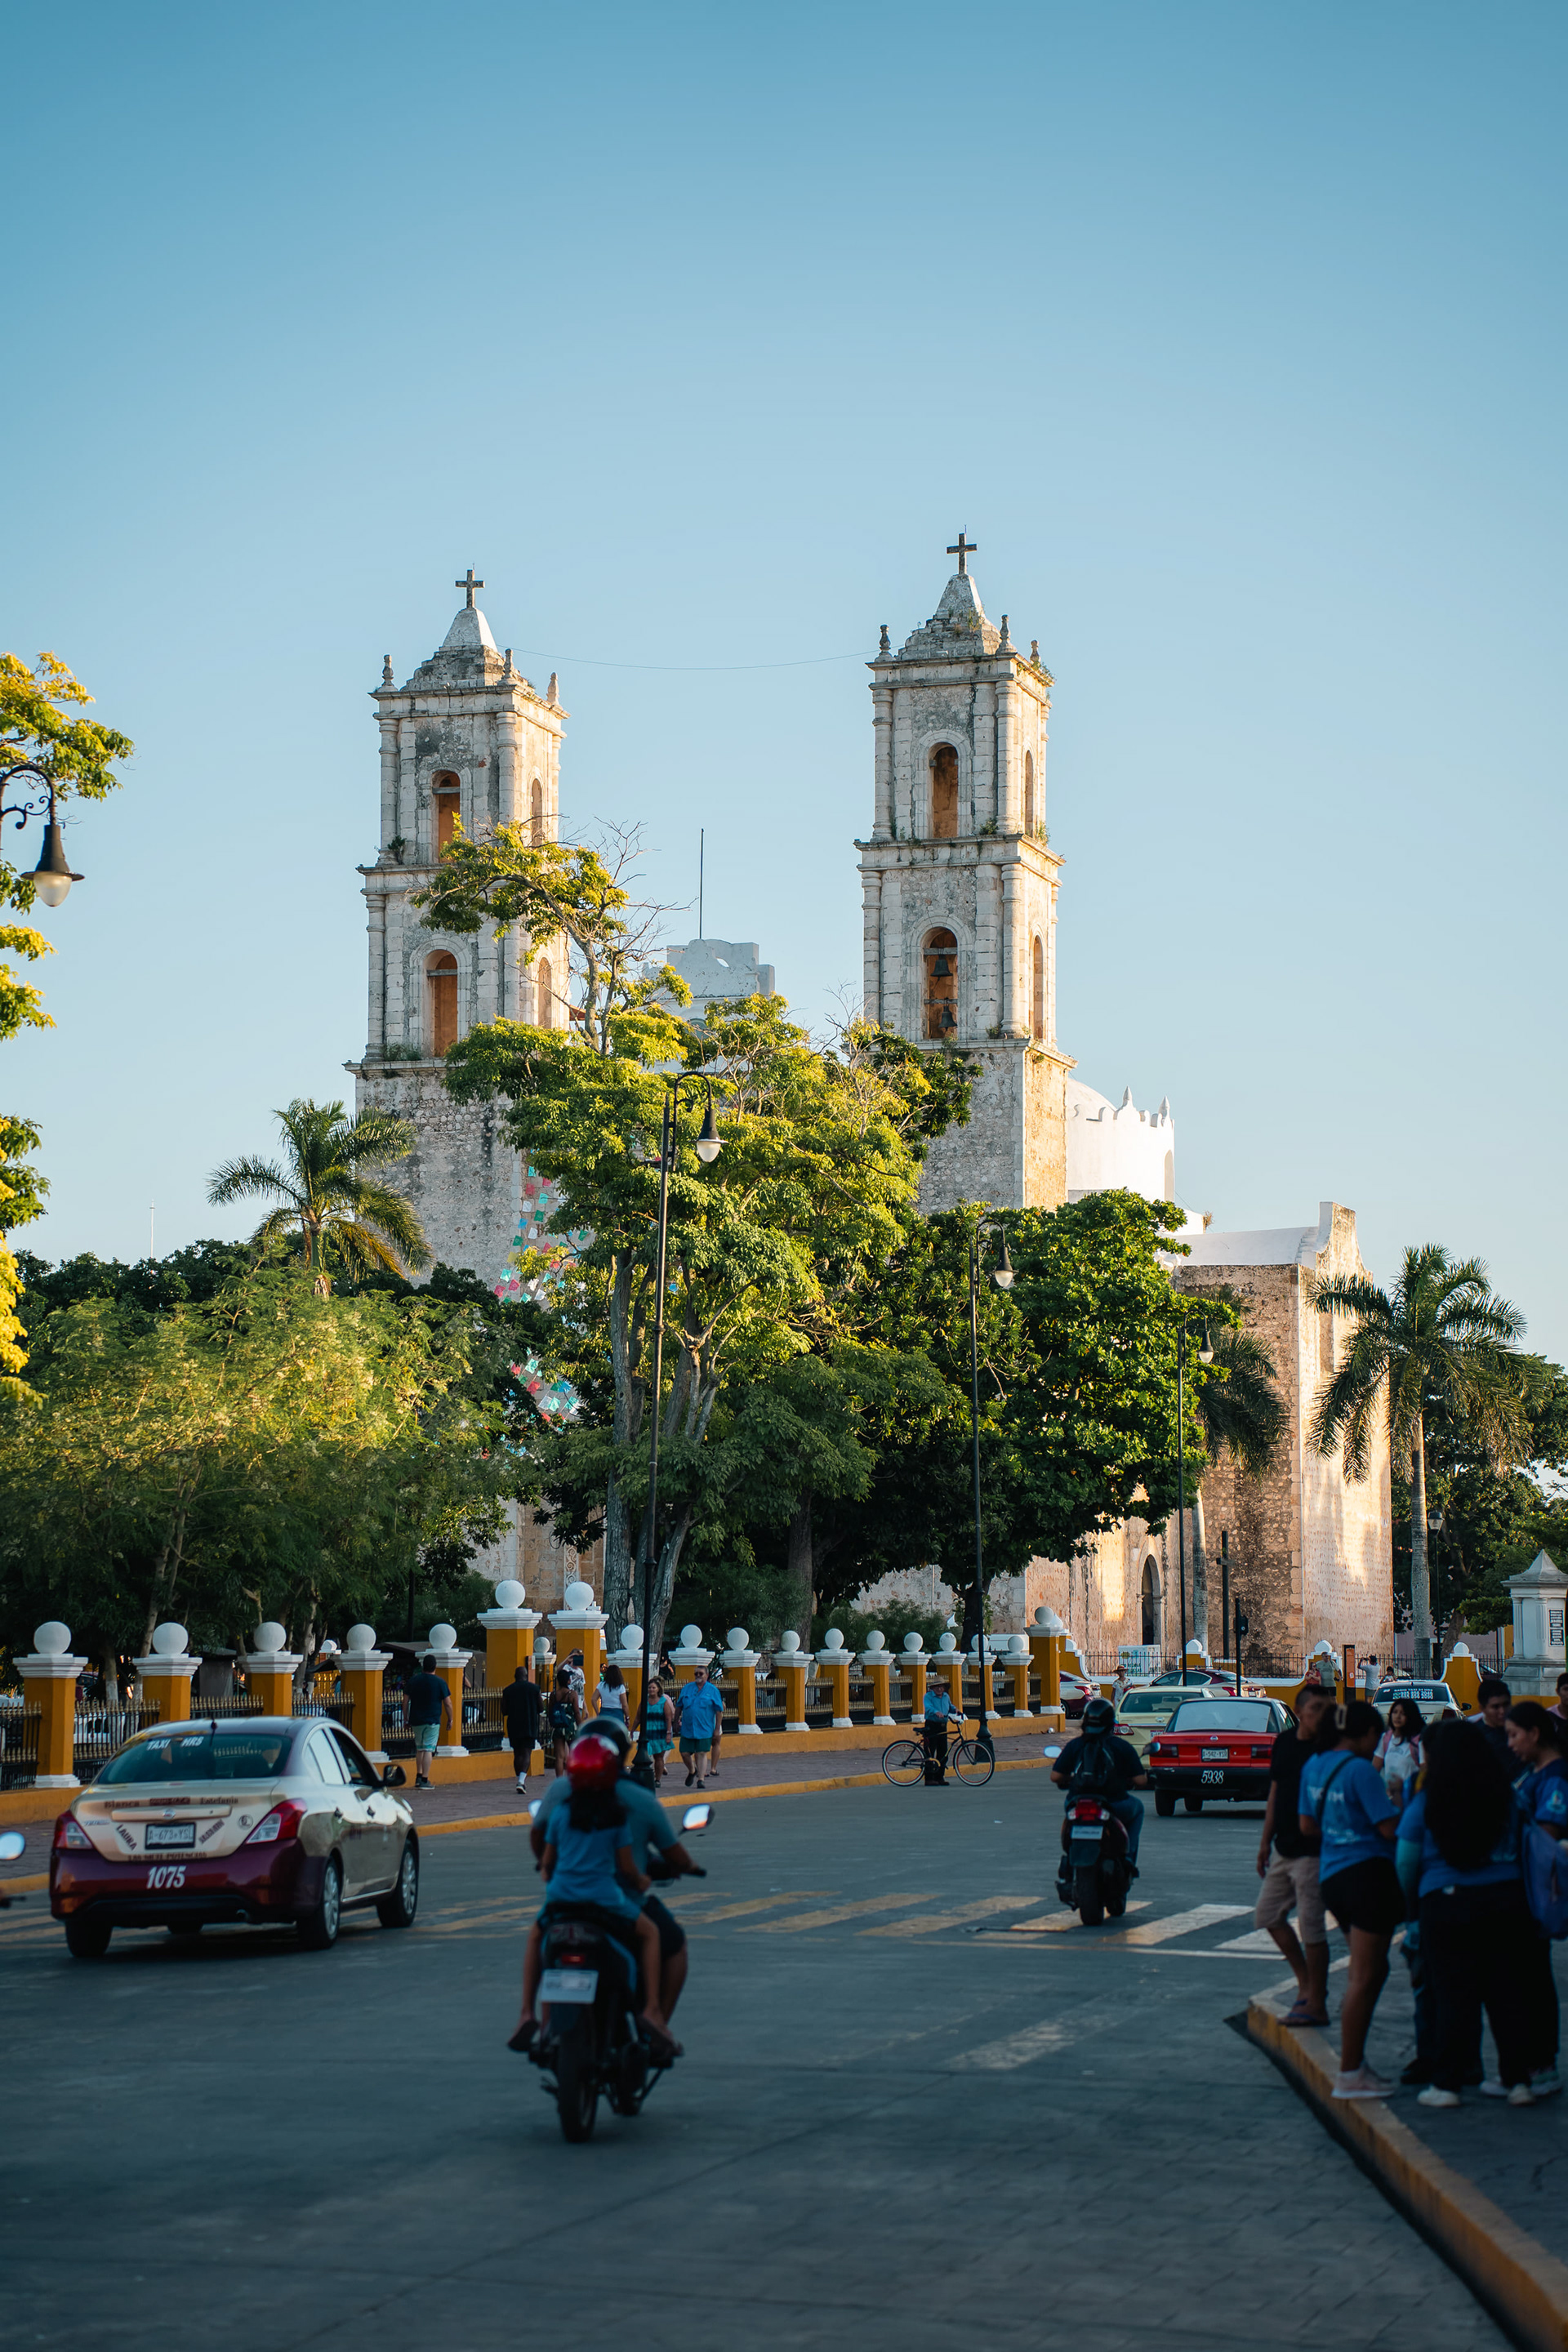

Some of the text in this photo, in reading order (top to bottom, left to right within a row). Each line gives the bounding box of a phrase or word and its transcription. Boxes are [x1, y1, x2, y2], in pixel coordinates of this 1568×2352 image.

[147, 1740, 171, 1750] TAXI
[1200, 1770, 1224, 1784] 5938
[116, 1824, 137, 1851] LAURA
[147, 1866, 186, 1889] 1075
